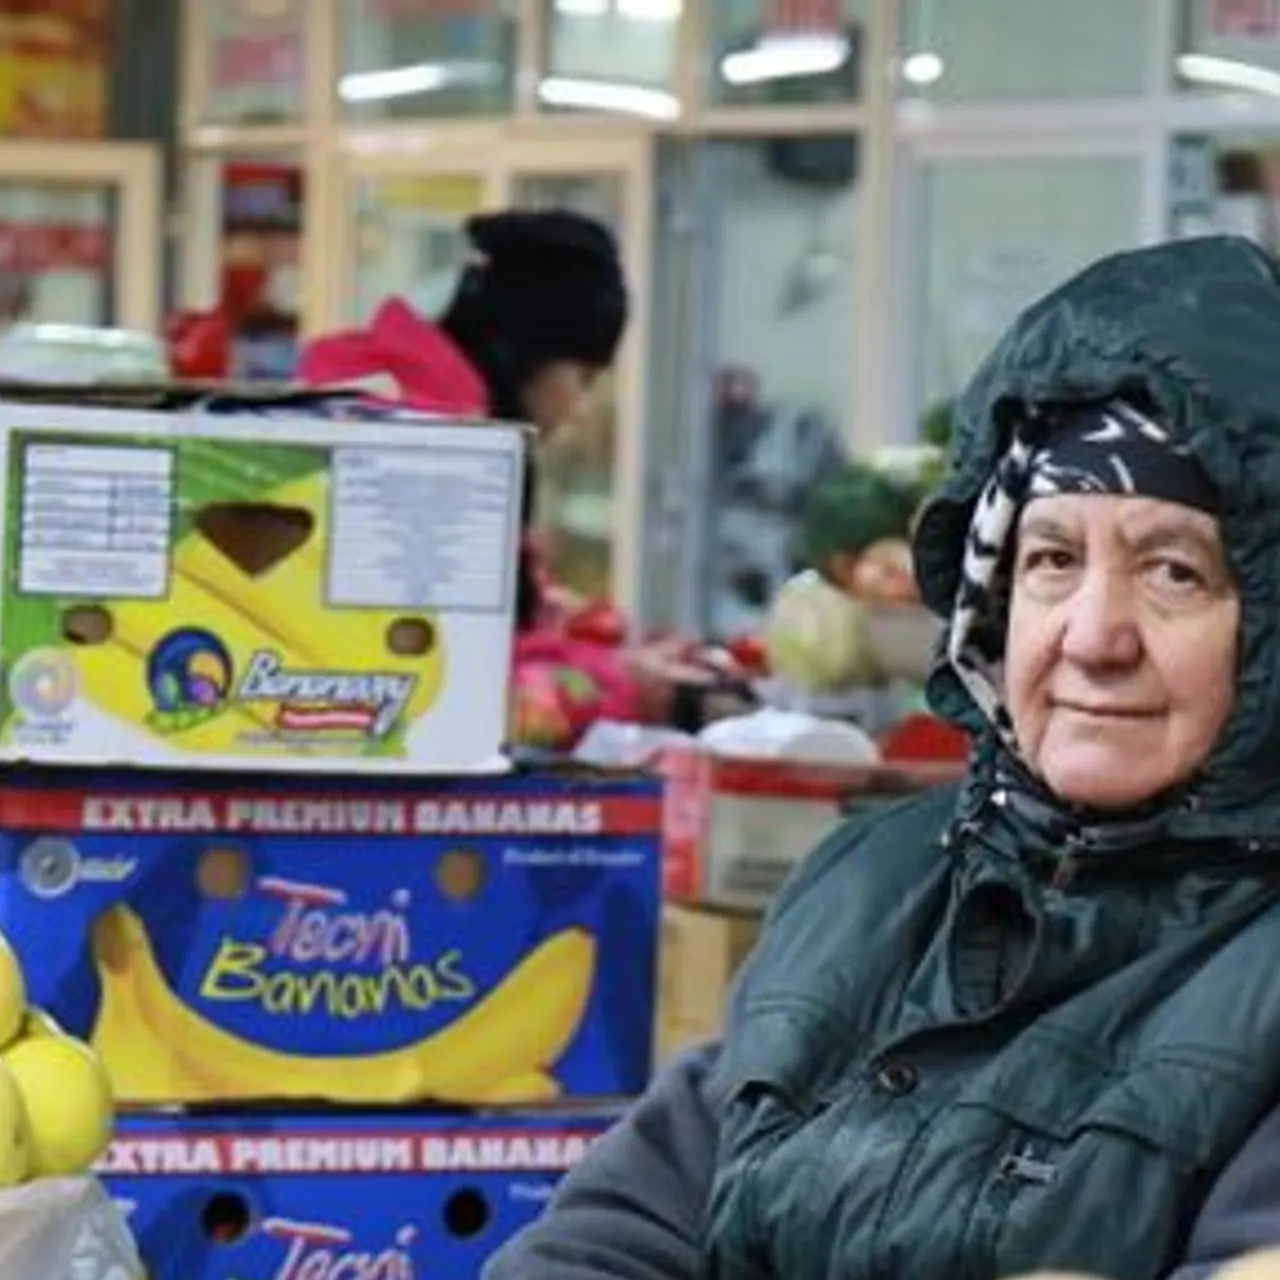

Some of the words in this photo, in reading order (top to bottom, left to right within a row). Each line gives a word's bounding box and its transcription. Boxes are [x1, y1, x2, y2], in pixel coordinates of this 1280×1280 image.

[82, 796, 215, 831] EXTRA
[227, 797, 405, 832] PREMIUM
[414, 800, 602, 834] BANANAS
[258, 876, 410, 966] Tecni
[200, 935, 475, 1019] Bananas
[231, 1137, 412, 1170] PREMIUM
[423, 1137, 593, 1168] BANANA
